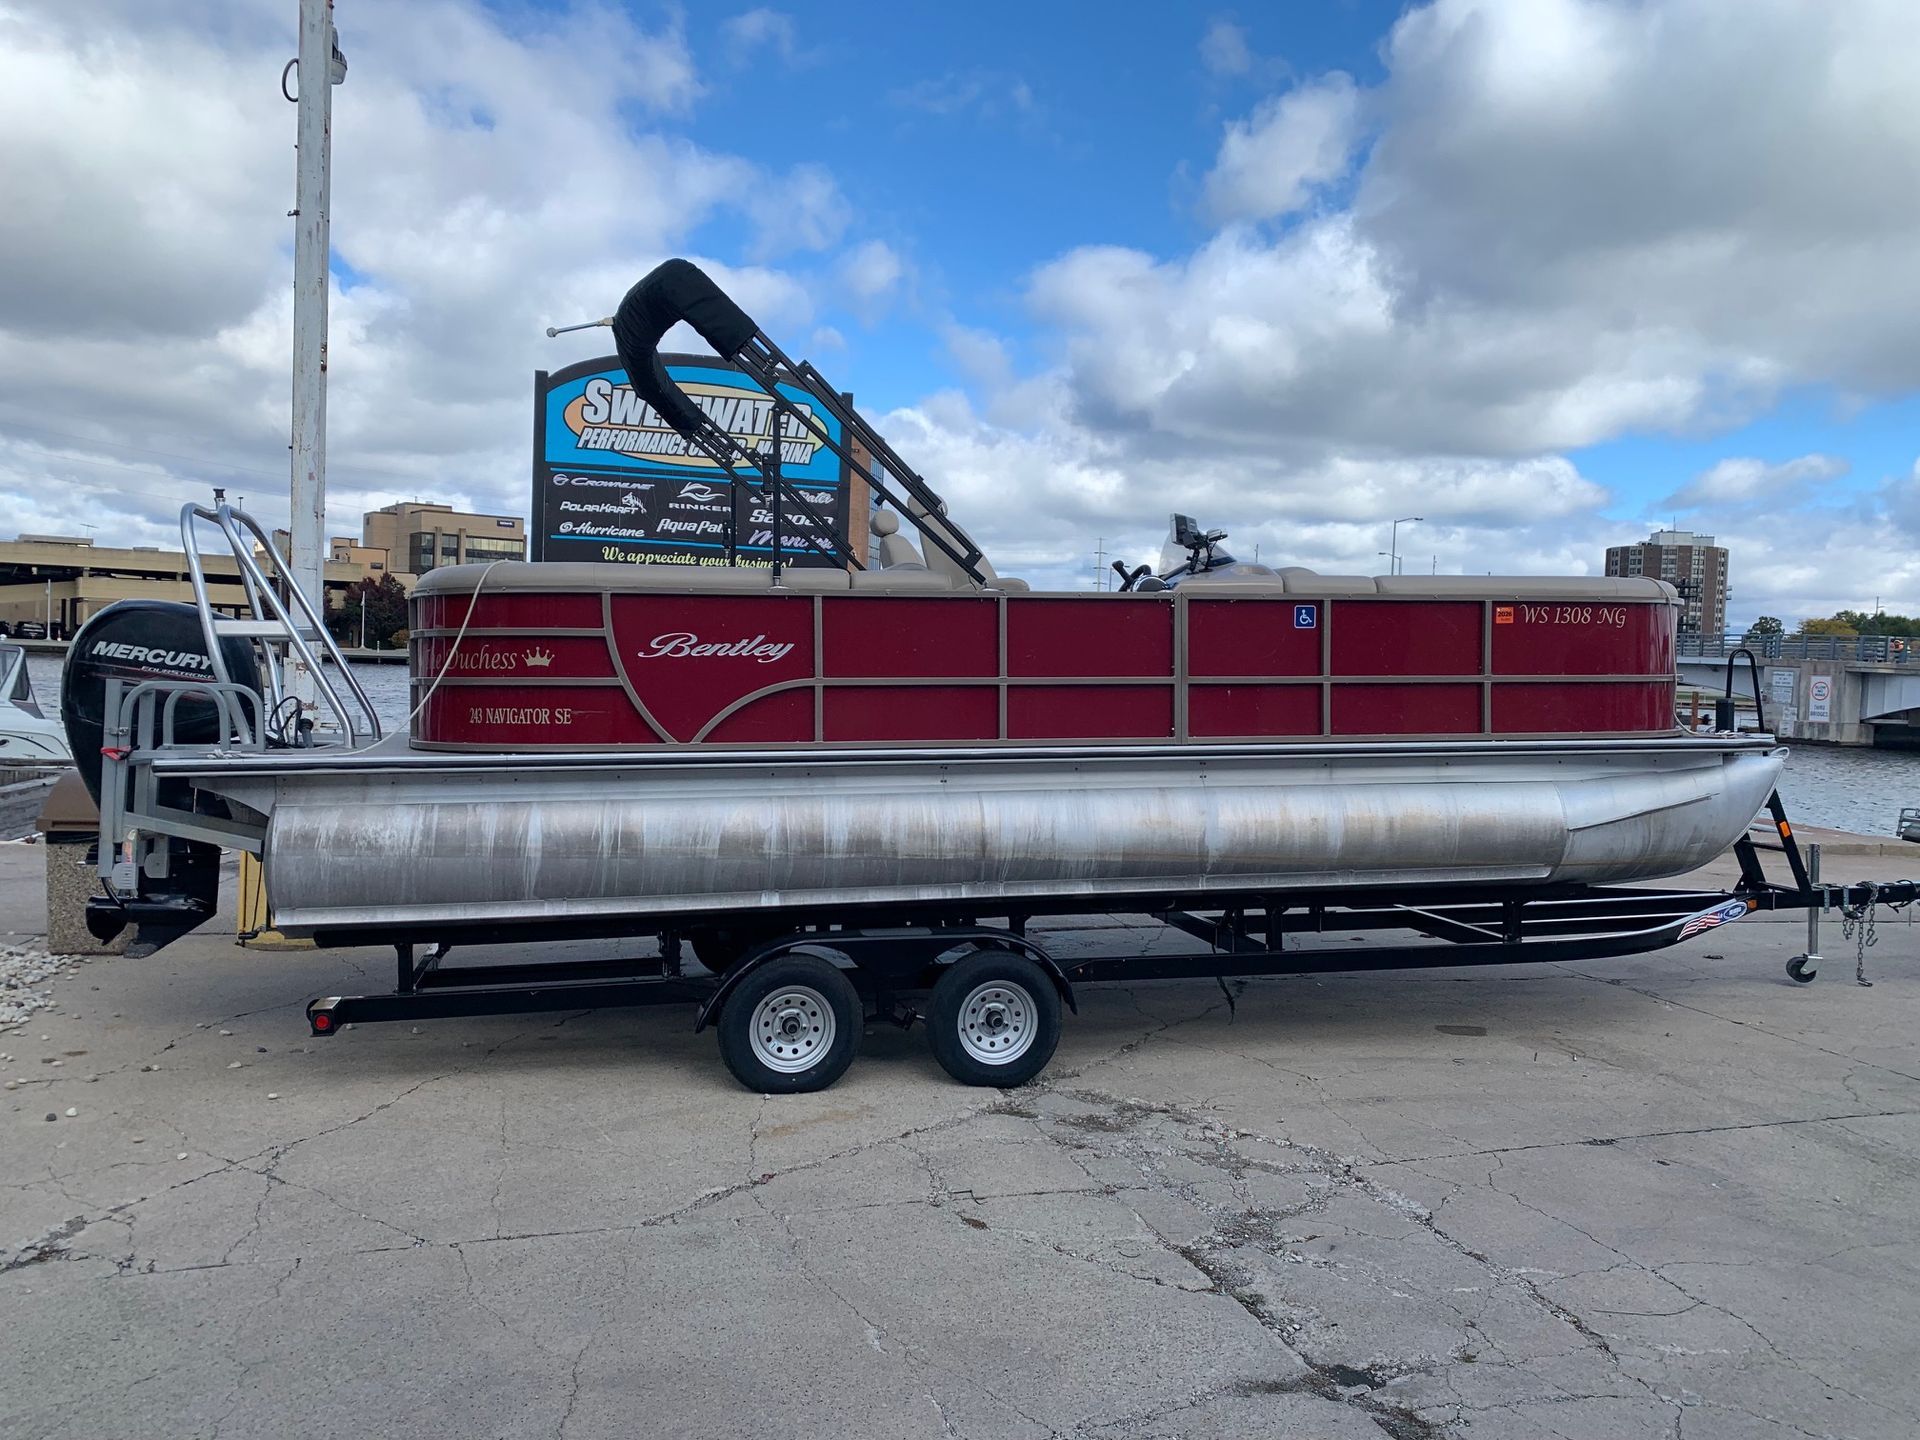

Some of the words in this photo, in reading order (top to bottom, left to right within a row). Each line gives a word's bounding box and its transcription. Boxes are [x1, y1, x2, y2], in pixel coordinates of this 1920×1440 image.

[577, 427, 687, 455] PERFORMANCE
[669, 503, 732, 512] RINKER
[573, 521, 645, 537] Hurricane
[602, 546, 625, 560] We
[627, 551, 697, 565] appreciate
[699, 558, 731, 567] your
[1520, 604, 1550, 624] WS
[1554, 607, 1592, 624] 1308
[1597, 607, 1627, 628] NG
[91, 641, 211, 670] MERCURY
[446, 644, 517, 669] Duchess
[637, 632, 795, 663] Bentley
[469, 707, 483, 724] 243
[485, 708, 551, 724] NAVIGATOR
[554, 708, 572, 724] SE
